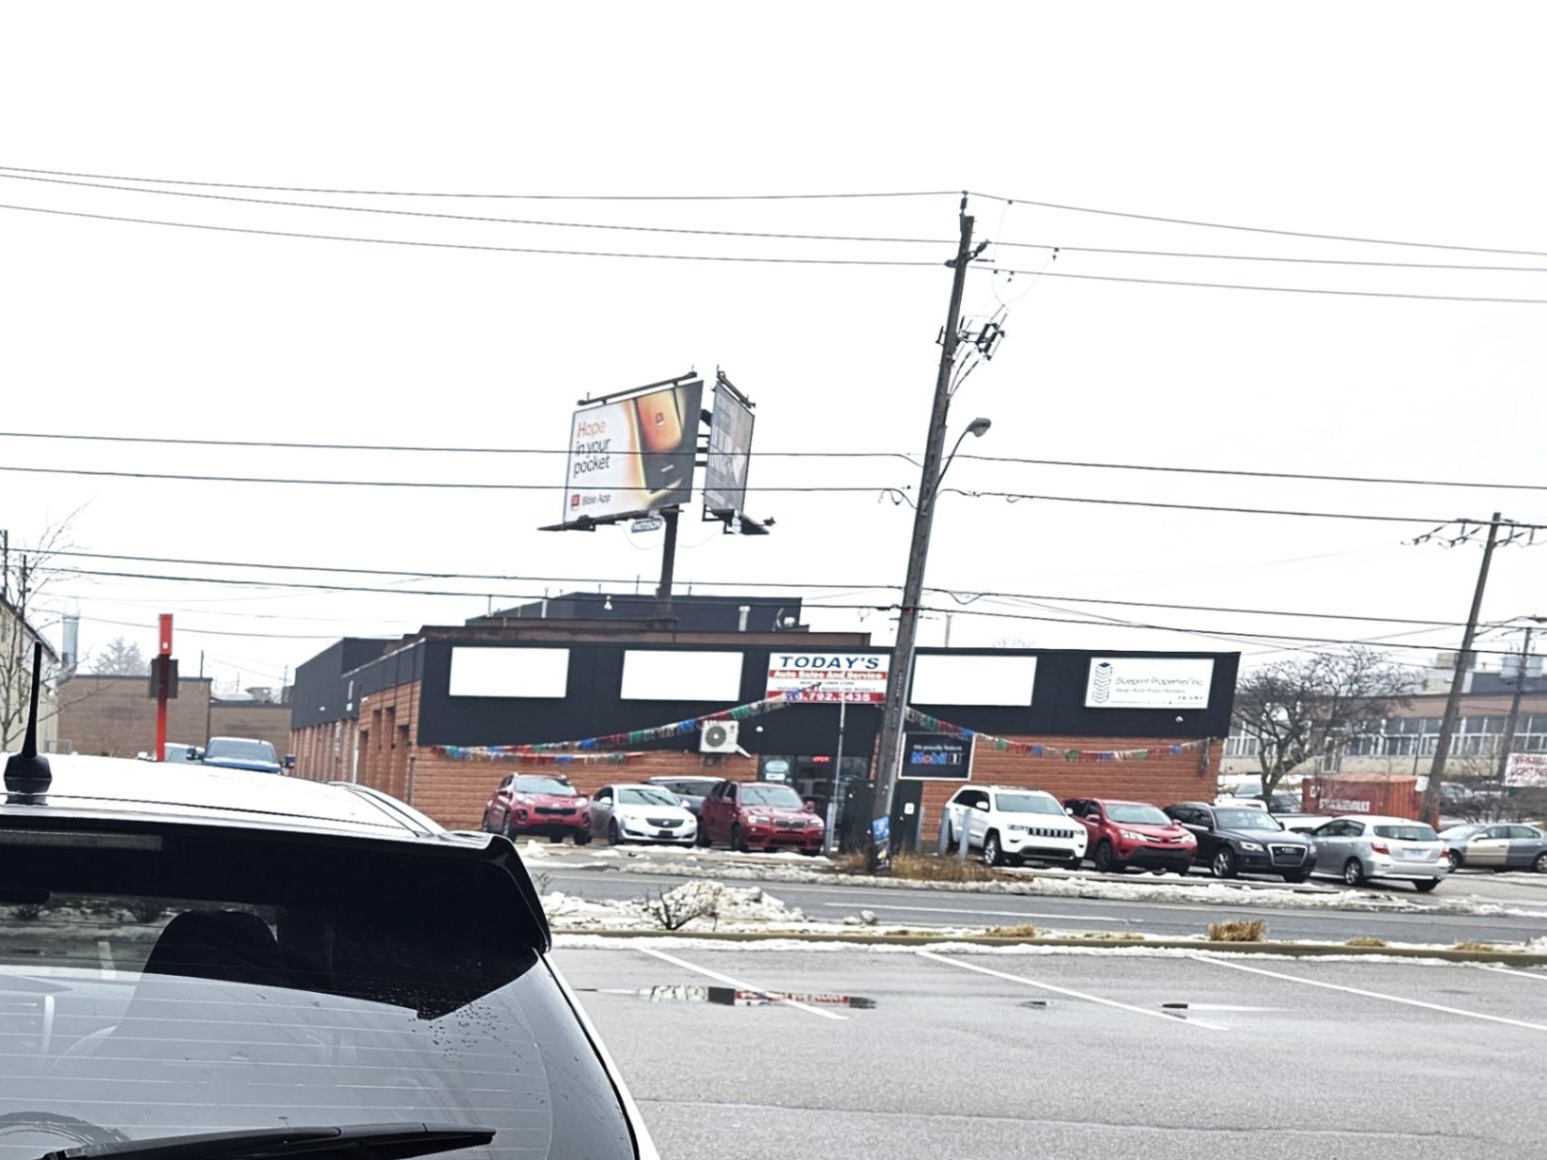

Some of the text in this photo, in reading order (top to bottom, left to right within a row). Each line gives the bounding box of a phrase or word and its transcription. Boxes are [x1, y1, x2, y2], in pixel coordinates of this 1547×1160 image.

[578, 420, 605, 438] Hope
[576, 439, 611, 458] in your
[573, 456, 610, 478] pocket
[780, 656, 879, 669] TODAY'S
[774, 671, 883, 680] Auto Sales And Service
[911, 751, 948, 765] Mobil
